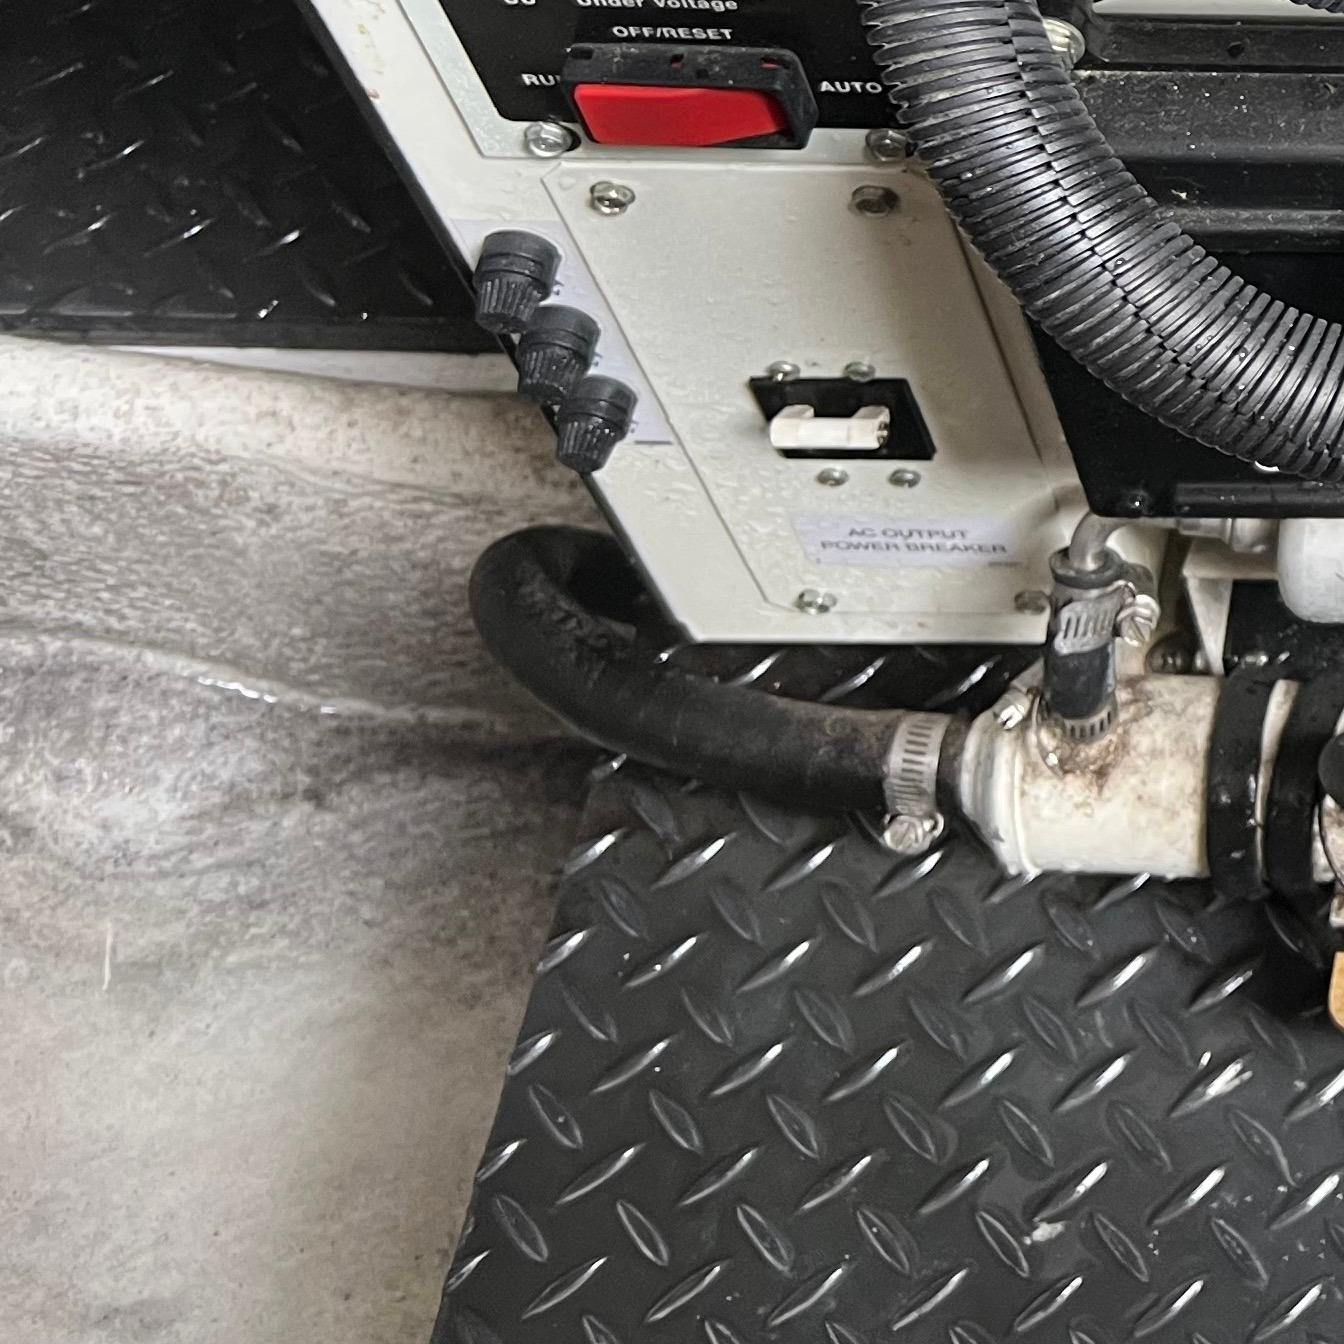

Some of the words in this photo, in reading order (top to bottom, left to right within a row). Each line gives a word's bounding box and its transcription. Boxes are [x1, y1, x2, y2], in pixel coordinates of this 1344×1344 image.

[612, 25, 734, 41] OFF/RESET
[819, 80, 884, 94] AUTO
[848, 527, 877, 538] AC
[881, 527, 967, 540] OUTPUT
[820, 540, 900, 552] POWER
[905, 542, 1008, 554] BREAKER
